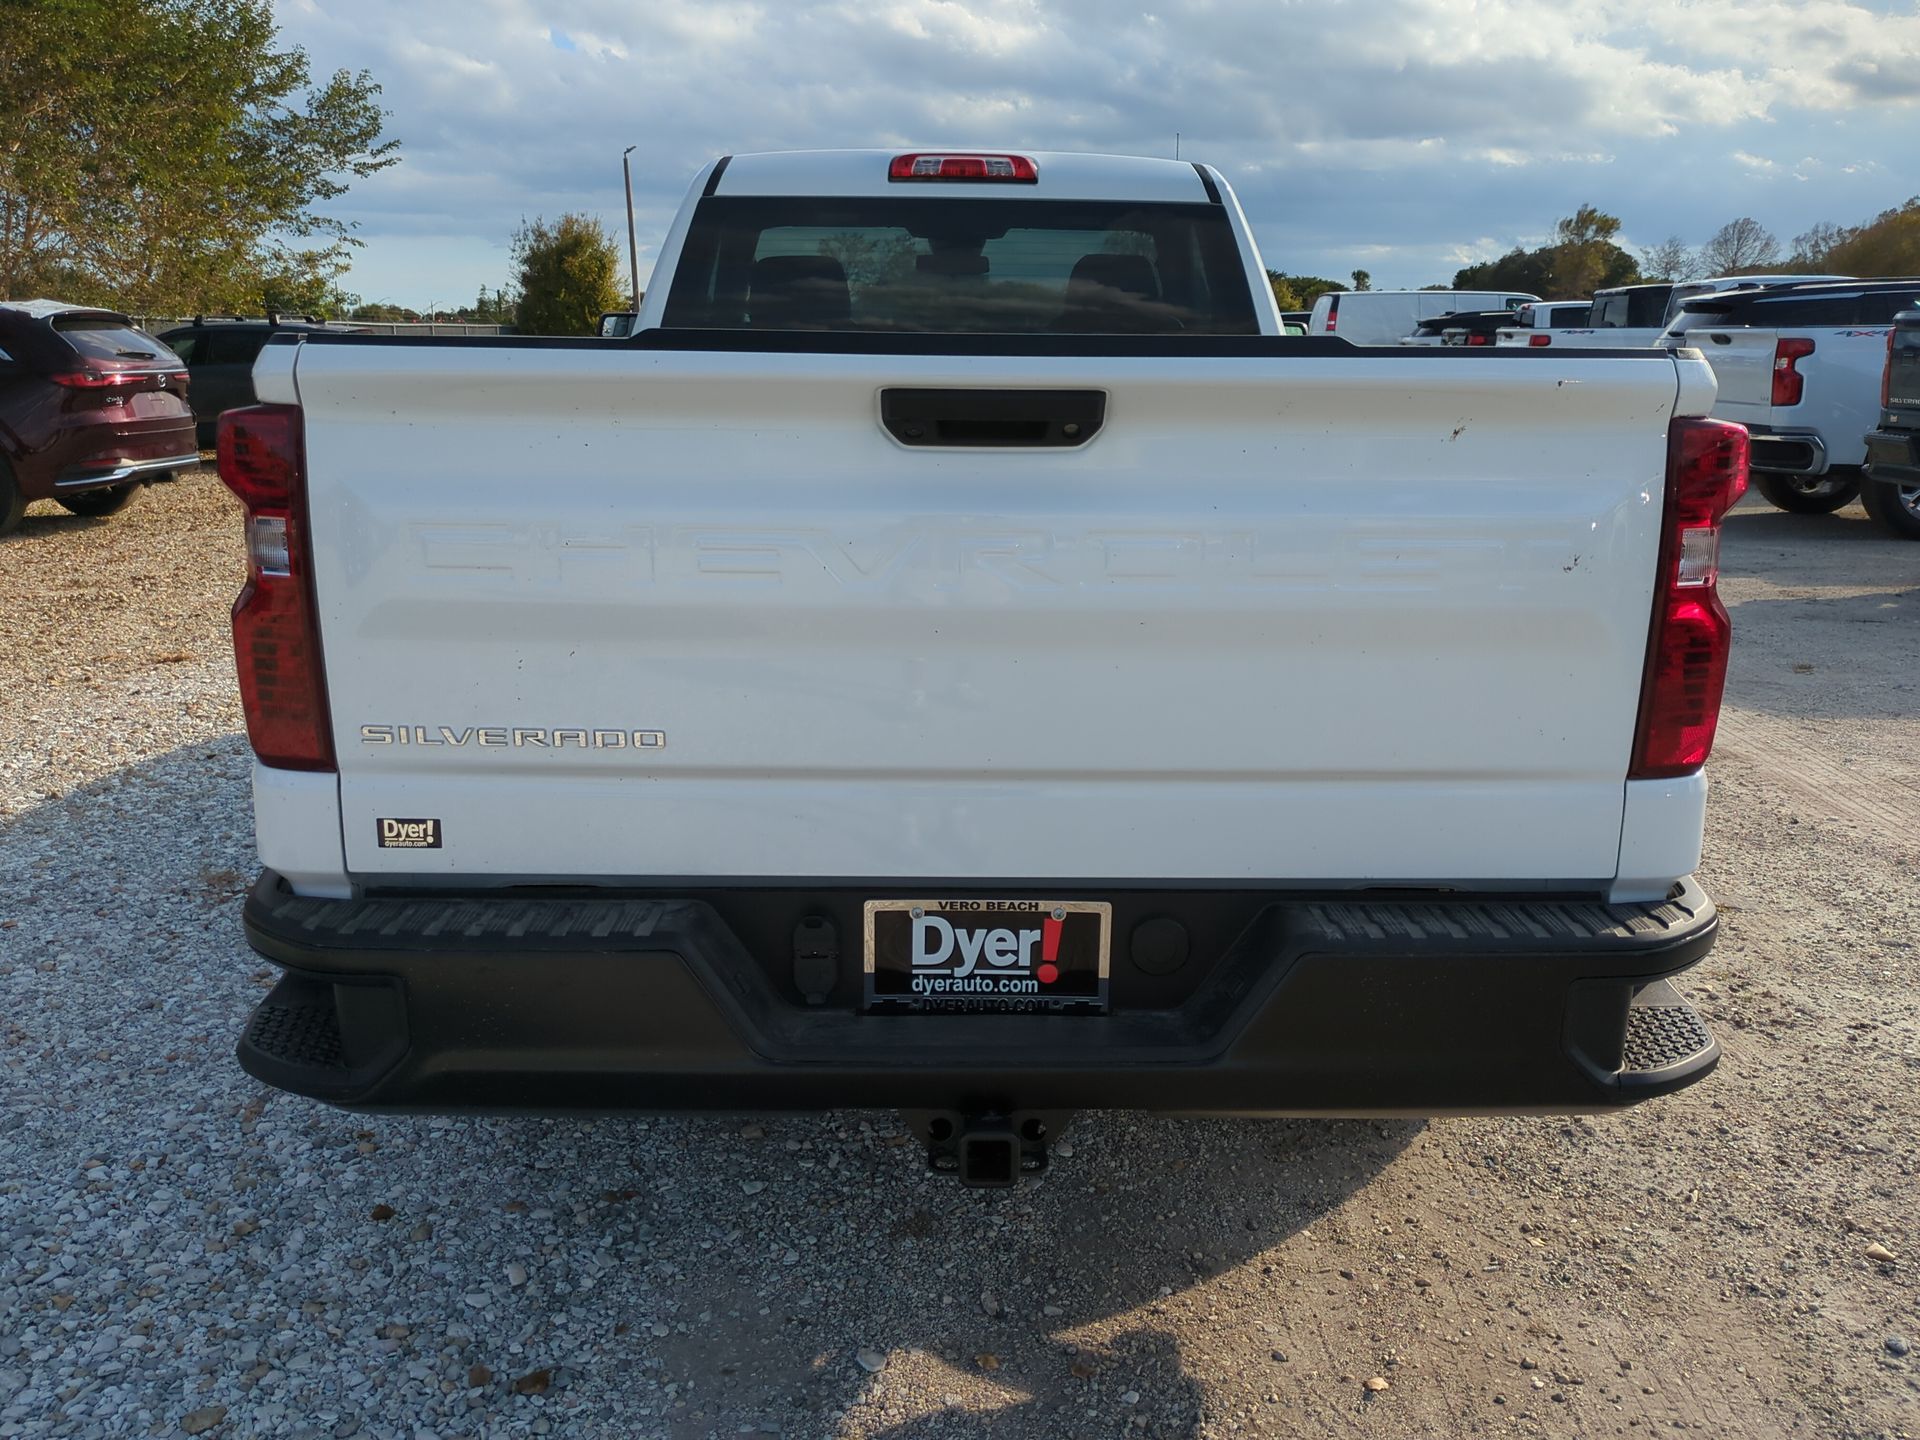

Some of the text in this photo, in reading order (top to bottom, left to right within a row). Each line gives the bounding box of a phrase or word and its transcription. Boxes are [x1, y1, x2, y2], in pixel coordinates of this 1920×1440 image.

[408, 521, 1584, 592] CHEVROLET
[361, 725, 668, 748] SILVERADO
[382, 819, 434, 844] Dyer!
[938, 901, 1039, 912] VERO BEACH
[911, 914, 1063, 984] Dyer!
[911, 974, 1038, 995] dyerauto.com
[922, 997, 1052, 1012] DYERAUTO.COM
